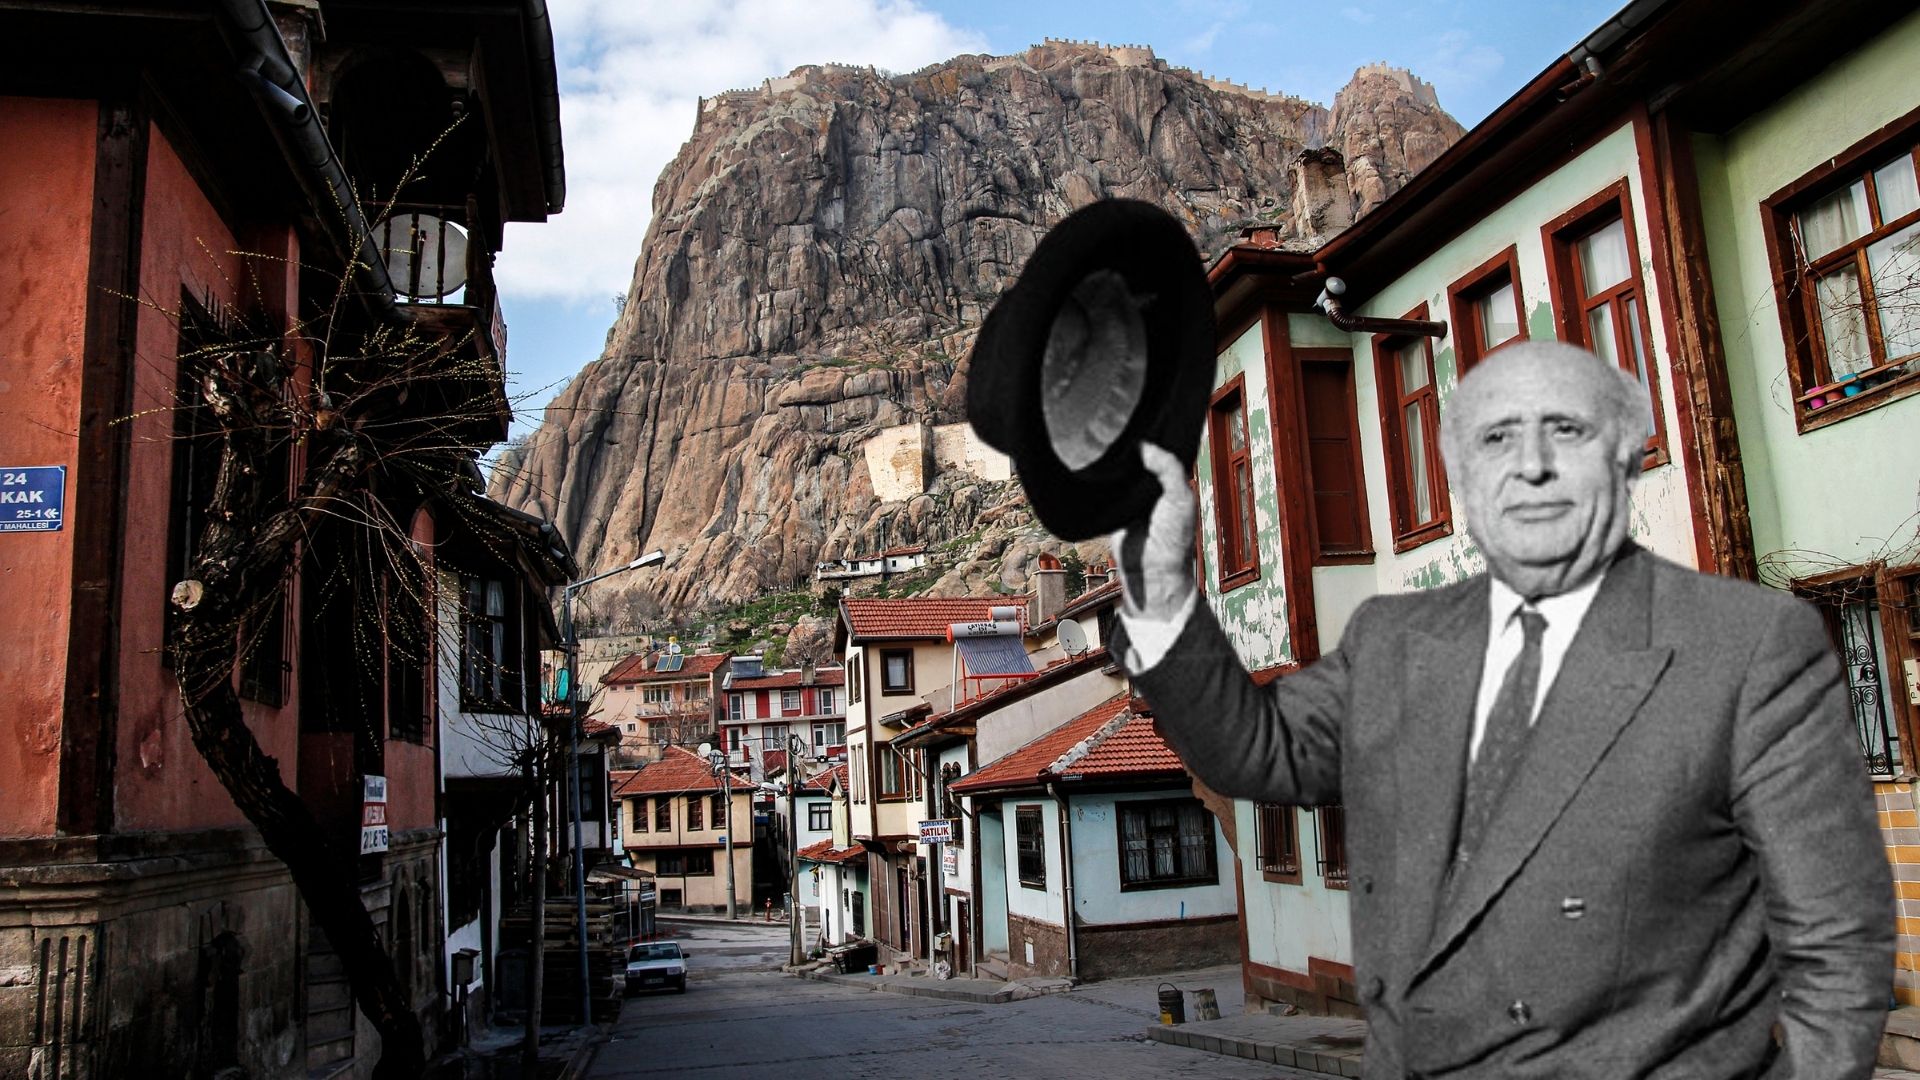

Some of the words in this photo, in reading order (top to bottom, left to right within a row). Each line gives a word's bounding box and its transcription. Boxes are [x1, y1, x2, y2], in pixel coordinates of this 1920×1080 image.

[3, 473, 27, 485] 24
[16, 510, 41, 518] 25-1
[921, 827, 949, 837] SATILIK
